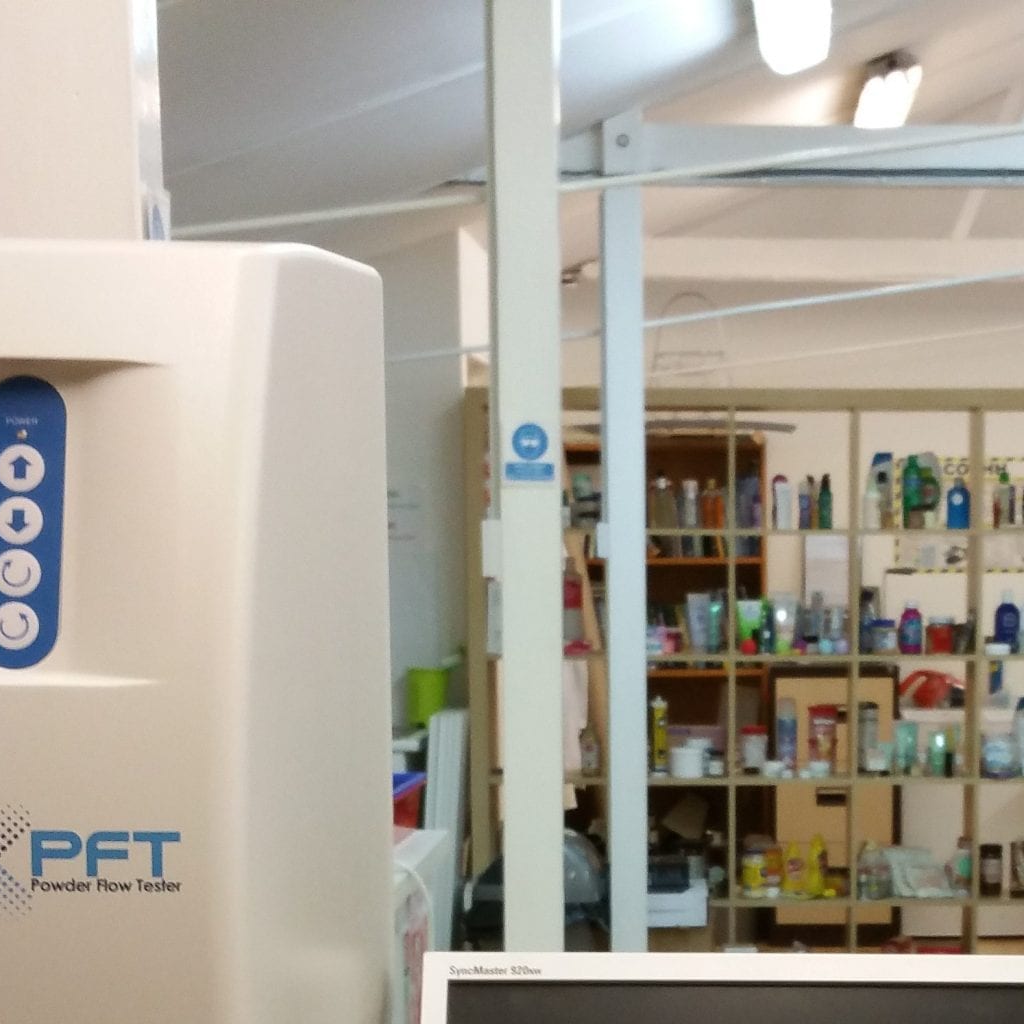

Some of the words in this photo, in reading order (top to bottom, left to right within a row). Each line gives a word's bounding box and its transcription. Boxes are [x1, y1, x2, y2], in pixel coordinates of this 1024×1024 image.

[30, 829, 181, 878] PFT
[31, 878, 91, 892] Powder
[97, 878, 132, 893] Flow
[136, 879, 183, 893] Tester
[449, 965, 507, 976] SyncMaster
